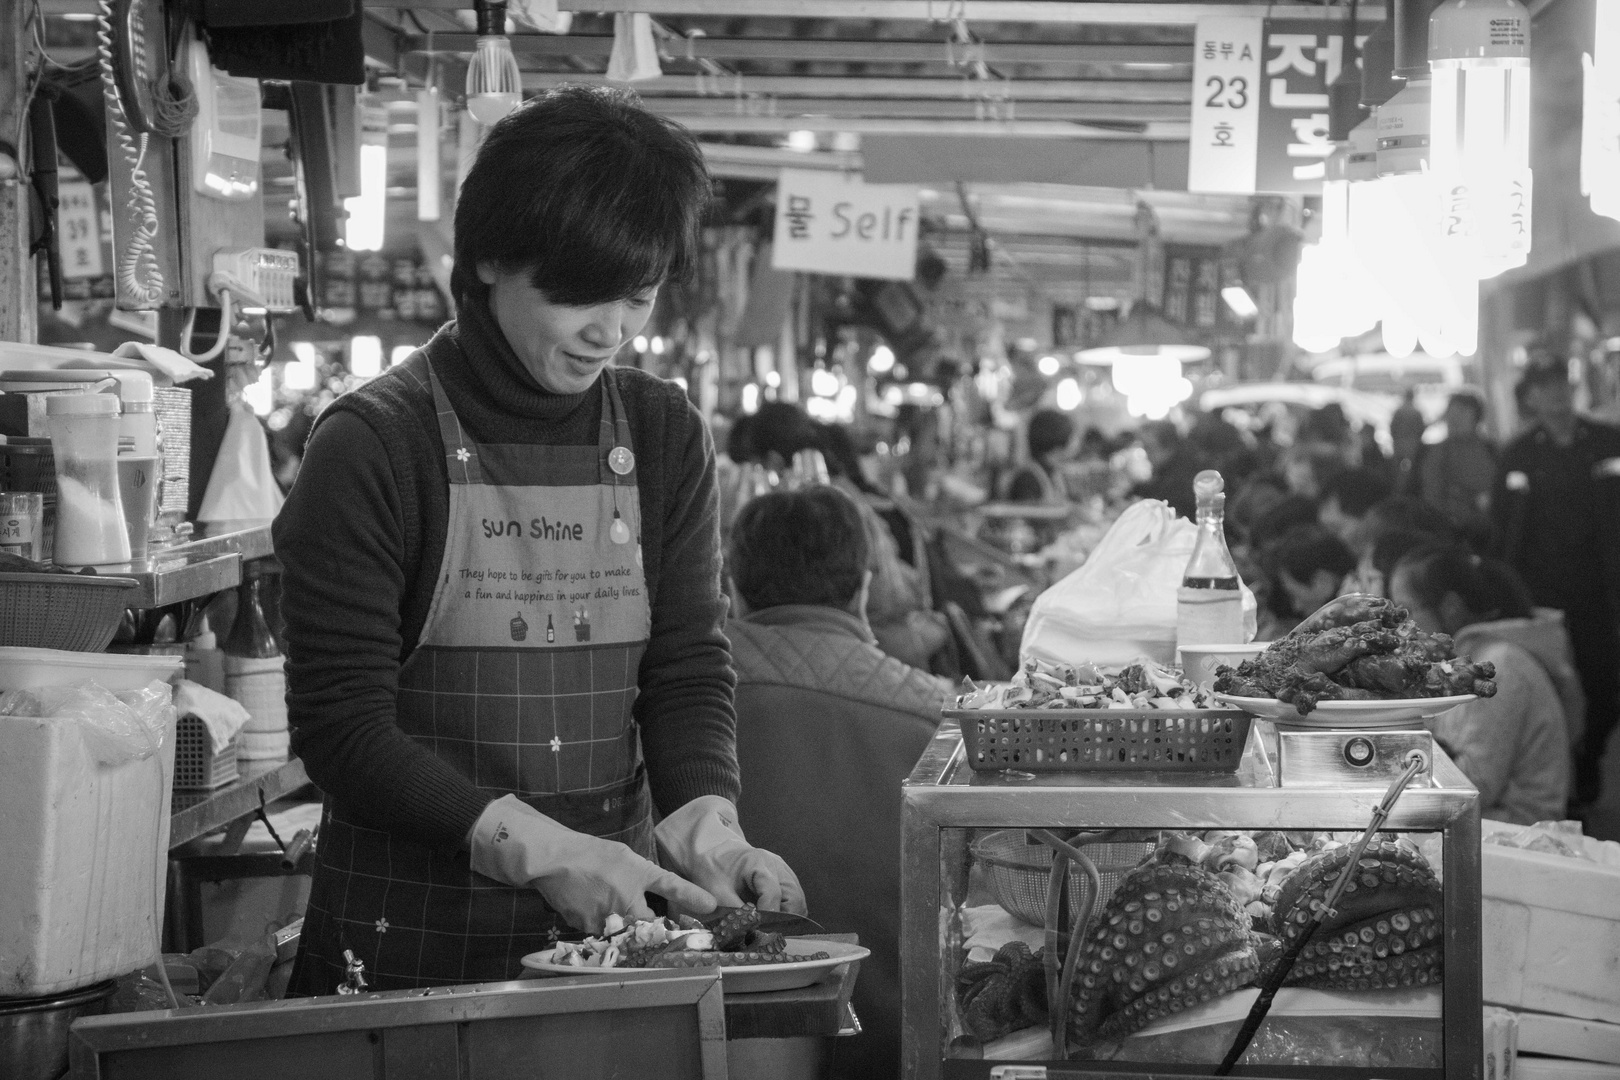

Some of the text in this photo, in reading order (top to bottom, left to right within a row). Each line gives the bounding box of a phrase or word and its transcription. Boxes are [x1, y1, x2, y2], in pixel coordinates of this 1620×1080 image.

[1205, 75, 1249, 110] 23
[1211, 121, 1236, 148] 호
[784, 194, 914, 241] 물 Self
[459, 567, 485, 583] They
[487, 567, 508, 586] hope
[509, 570, 519, 582] to
[521, 569, 533, 582] be
[554, 568, 570, 581] for
[570, 572, 587, 584] you
[590, 568, 601, 580] to
[604, 565, 632, 578] make
[464, 590, 472, 599] a
[475, 587, 493, 600] fun
[495, 588, 512, 600] and
[556, 589, 567, 601] in
[569, 591, 591, 604] your
[594, 585, 620, 600] daily
